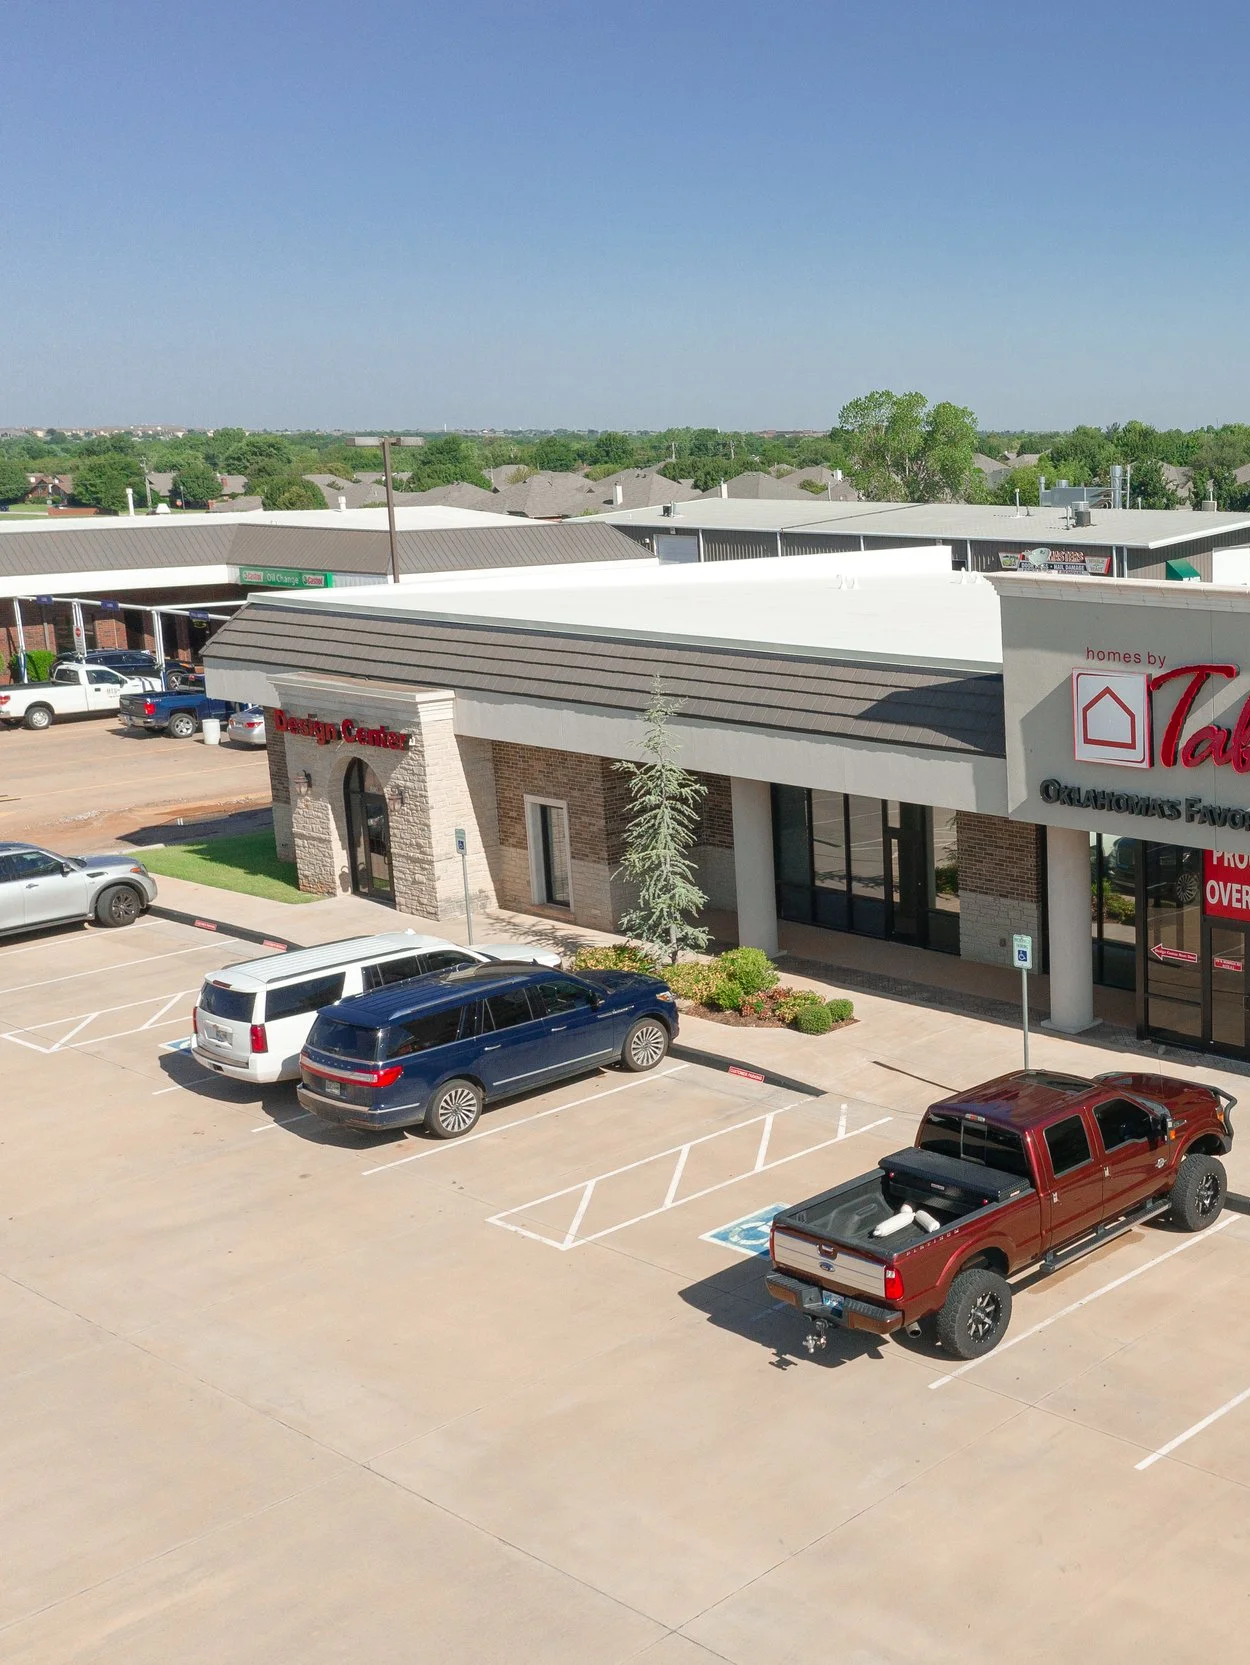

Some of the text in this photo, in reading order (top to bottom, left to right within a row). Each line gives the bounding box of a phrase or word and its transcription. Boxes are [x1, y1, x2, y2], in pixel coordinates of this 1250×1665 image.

[266, 573, 299, 585] Oil Change
[1086, 647, 1167, 669] homes by
[274, 708, 410, 751] Design Center
[1039, 778, 1182, 820] OKLAHOMA'S
